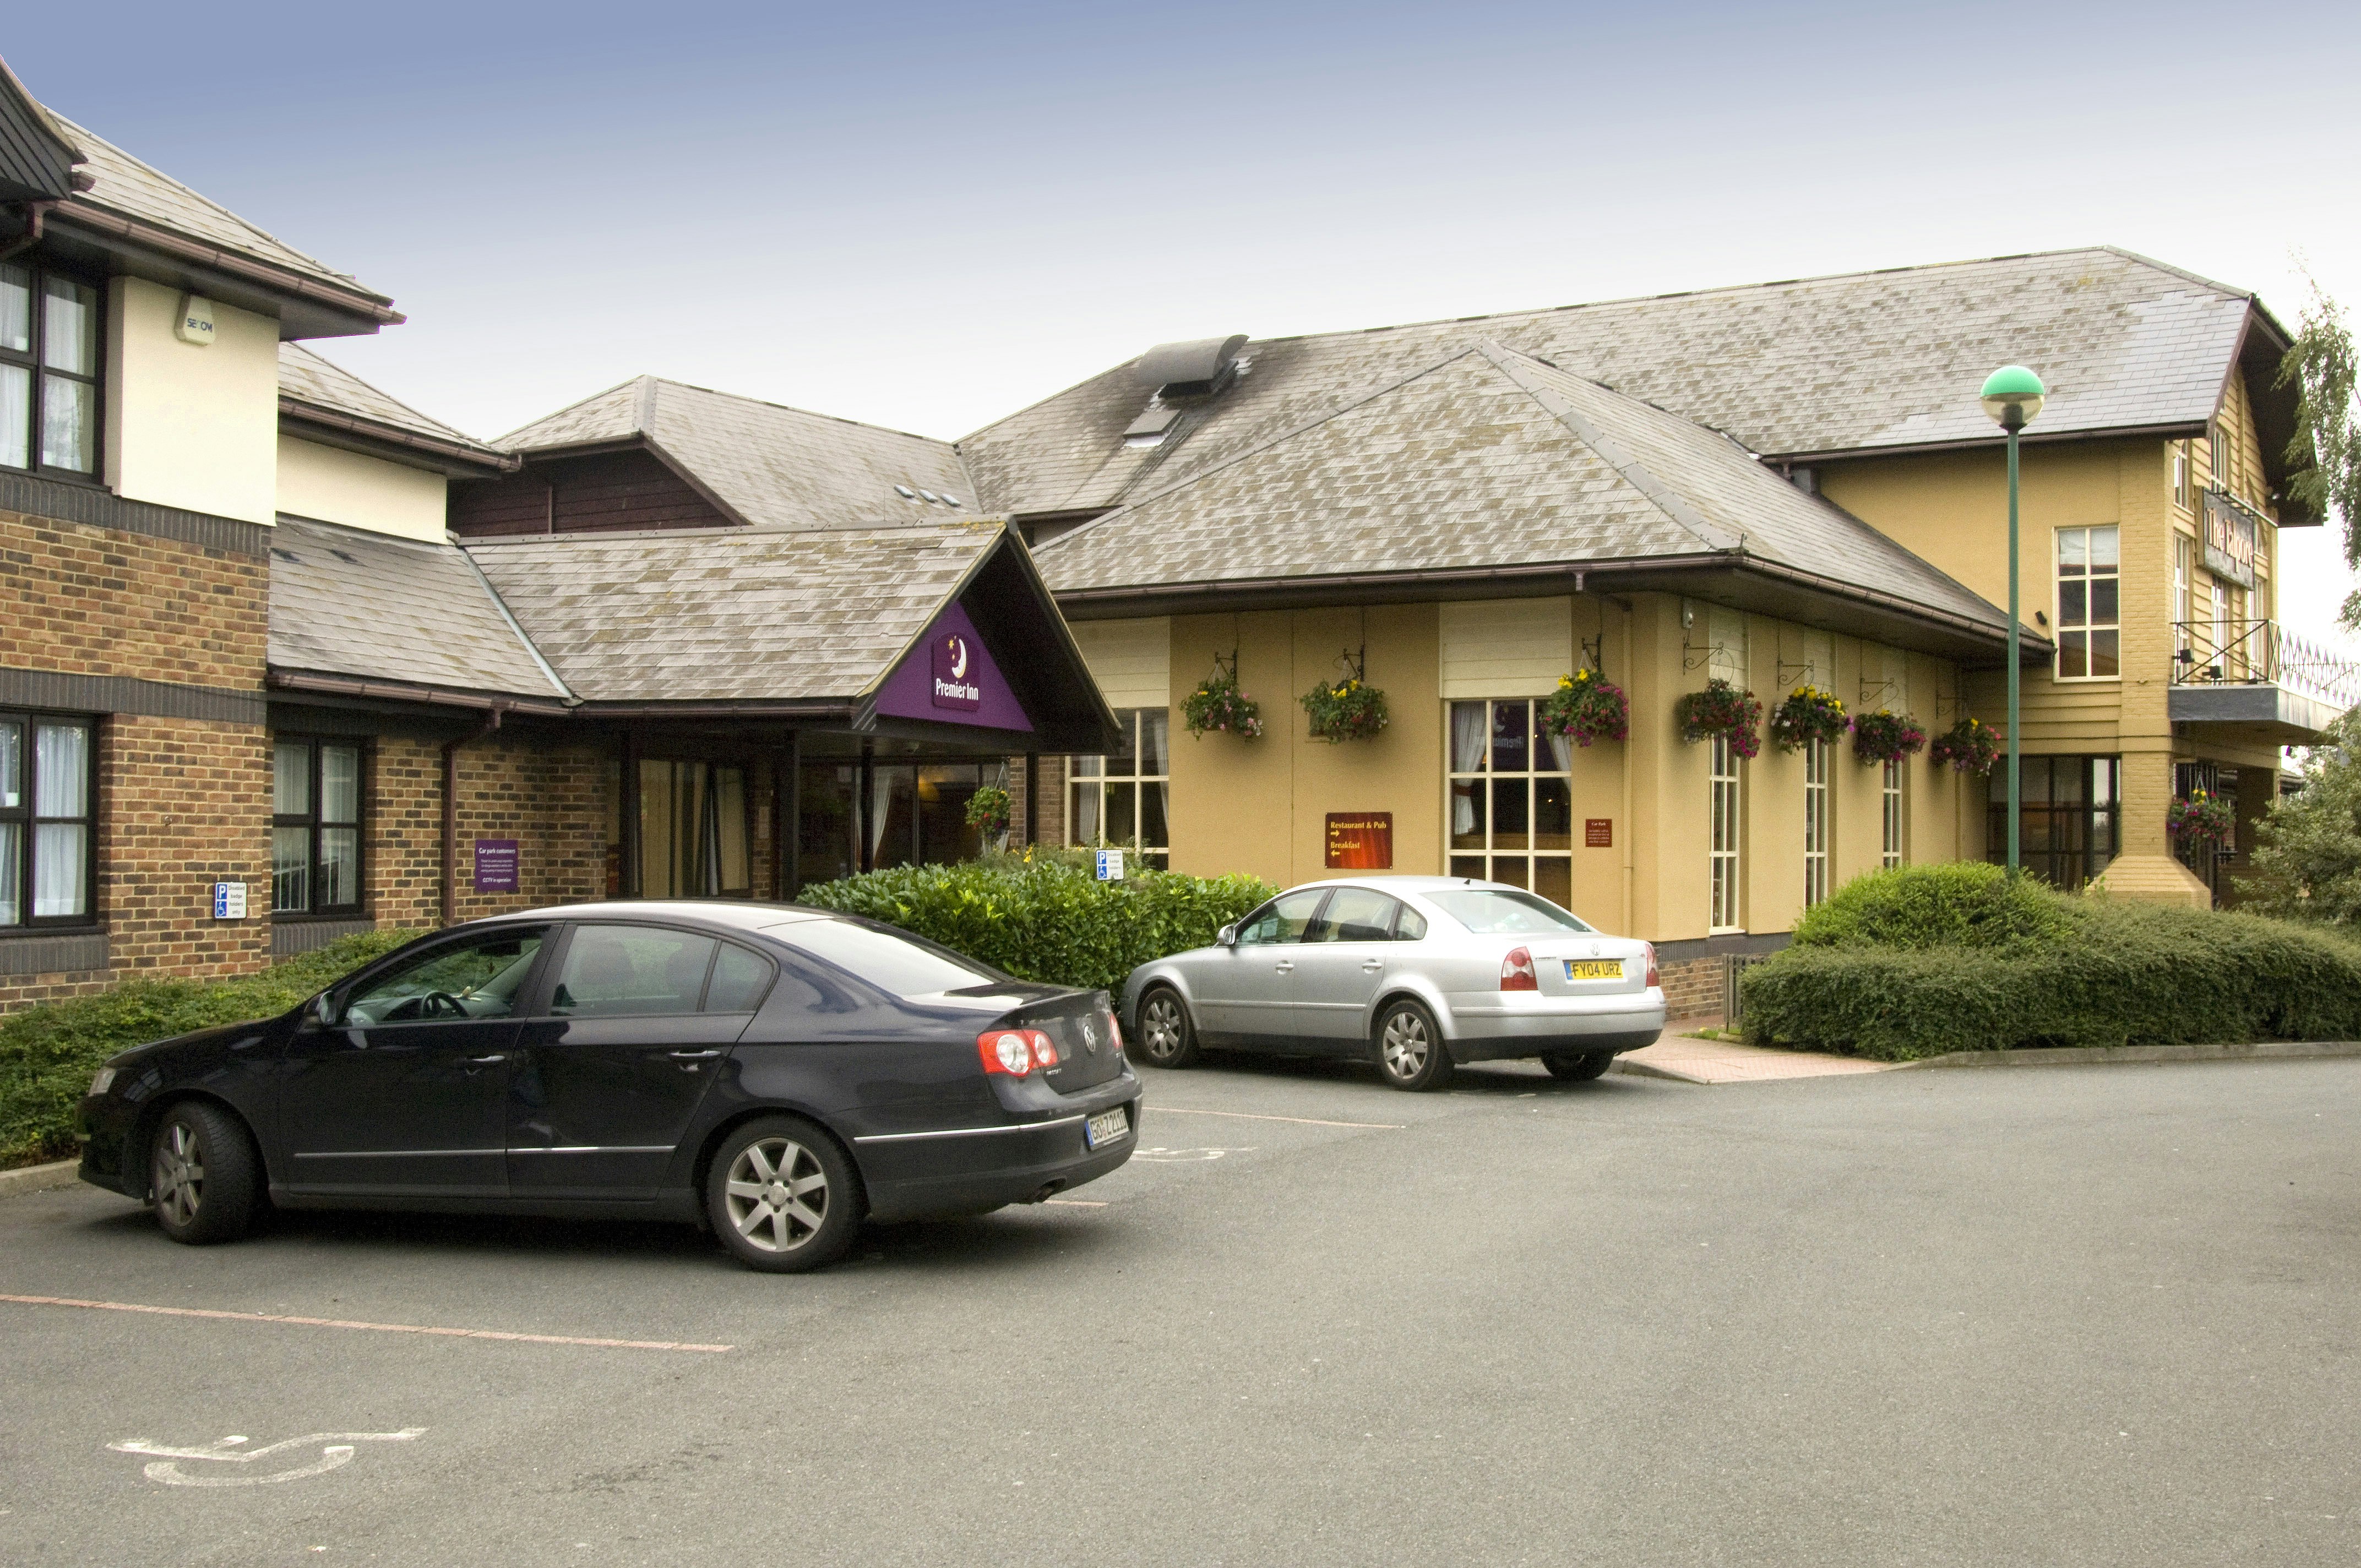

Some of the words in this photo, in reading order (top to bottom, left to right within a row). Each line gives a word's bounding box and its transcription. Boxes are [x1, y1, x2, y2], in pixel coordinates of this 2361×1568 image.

[2206, 508, 2224, 551] The
[936, 678, 966, 699] Premier
[967, 682, 978, 701] Inn
[219, 885, 226, 899] P
[1572, 963, 1600, 977] FY04
[1602, 963, 1622, 976] URZ
